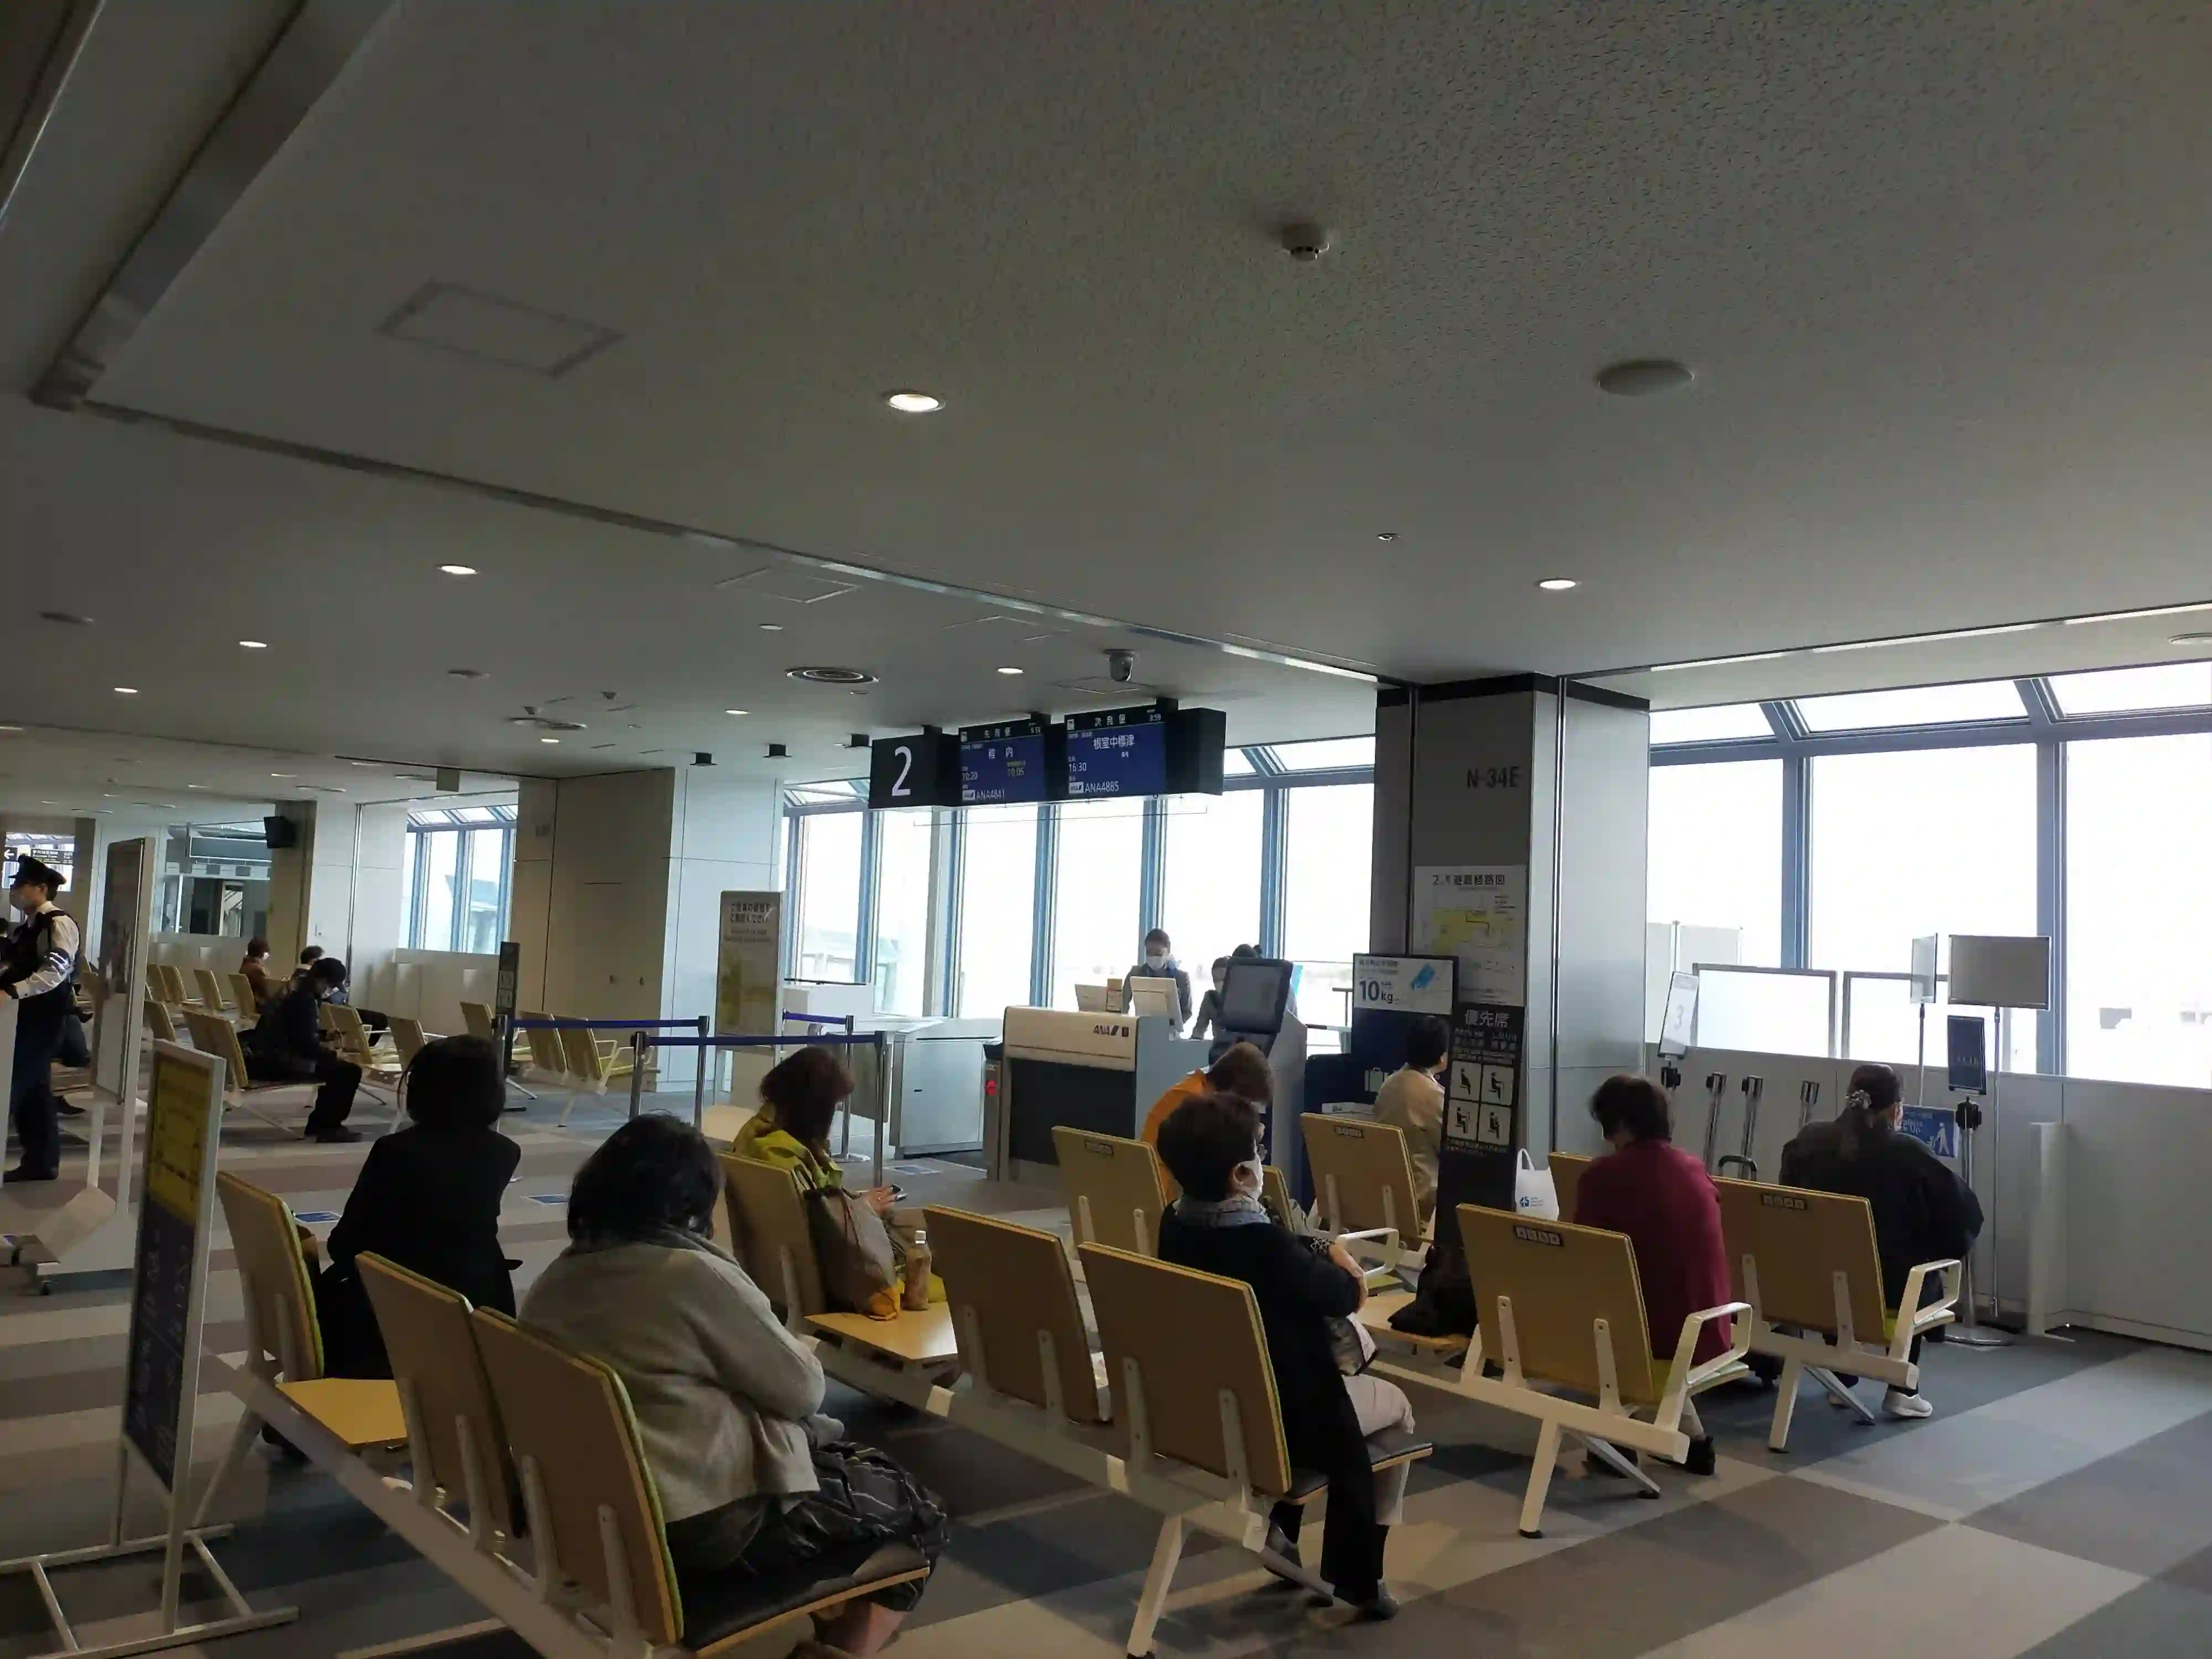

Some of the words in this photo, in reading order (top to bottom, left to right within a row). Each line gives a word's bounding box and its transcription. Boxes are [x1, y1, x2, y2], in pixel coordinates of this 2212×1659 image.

[891, 745, 911, 797] 2
[1068, 762, 1087, 772] 16:30
[962, 771, 978, 781] 10:20
[1467, 766, 1519, 789] N-34E
[1084, 781, 1119, 793] ANA4885
[1359, 979, 1380, 1001] 10
[1381, 990, 1393, 1004] kg
[1464, 1009, 1510, 1029] 優先席
[1093, 1025, 1109, 1036] ANA
